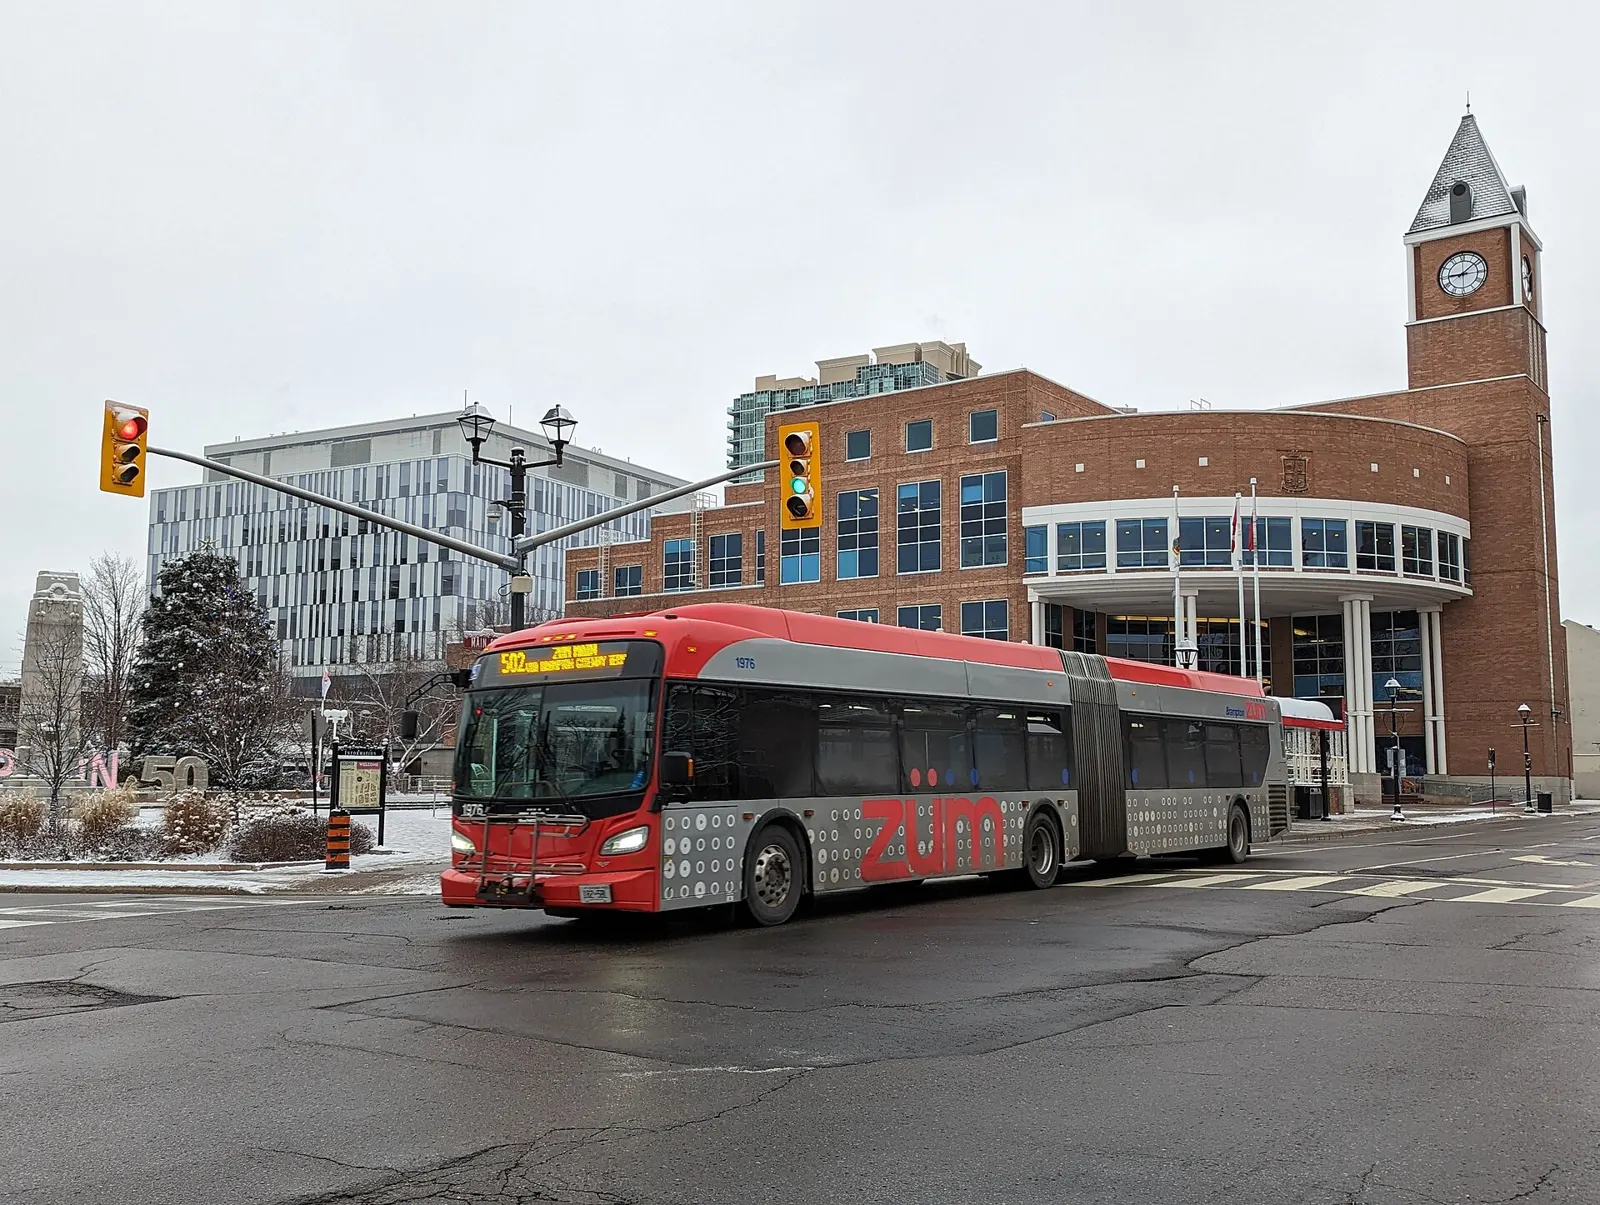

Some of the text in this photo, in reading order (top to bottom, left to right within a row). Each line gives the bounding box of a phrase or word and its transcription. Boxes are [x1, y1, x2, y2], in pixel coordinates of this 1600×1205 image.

[501, 651, 526, 674] 502
[735, 656, 756, 670] 1976
[140, 756, 209, 794] 50
[462, 803, 485, 817] 1976
